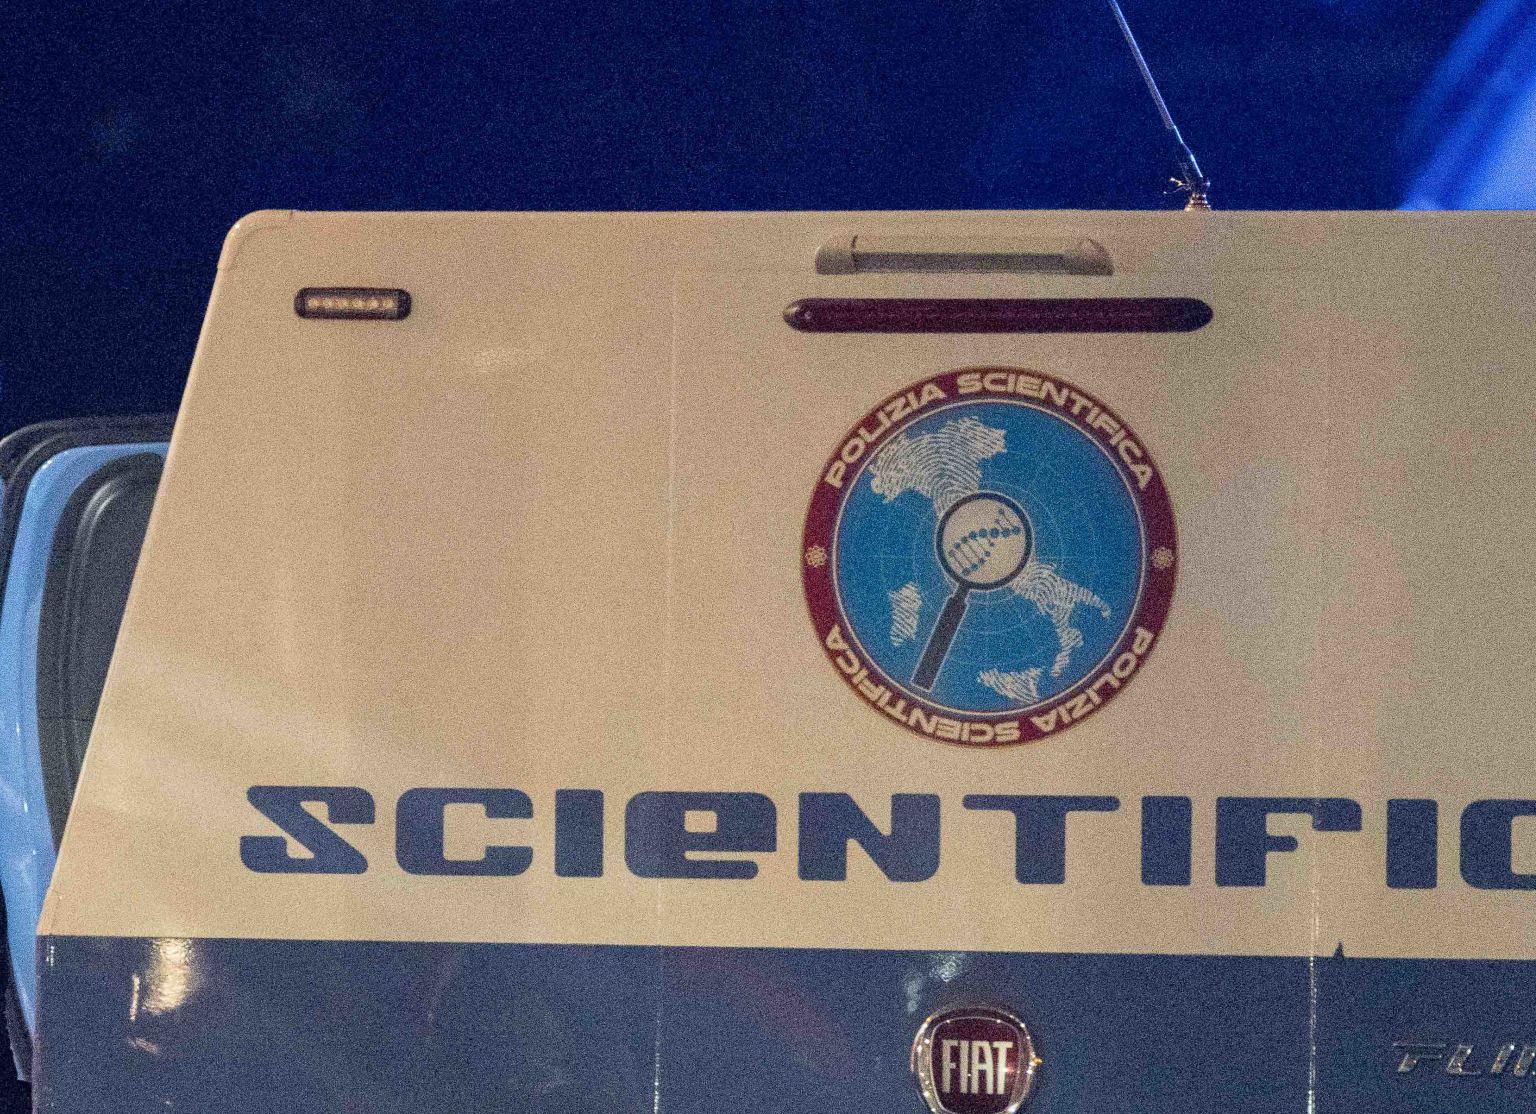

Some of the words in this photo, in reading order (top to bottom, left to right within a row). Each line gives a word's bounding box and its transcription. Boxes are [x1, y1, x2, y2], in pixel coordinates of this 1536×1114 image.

[826, 383, 947, 488] POLIZIA
[957, 372, 1153, 491] SCIENTIFICA
[824, 624, 1021, 743] SCIENTIFICA
[1031, 627, 1152, 734] POLIZIA
[940, 1038, 1014, 1096] FIAT
